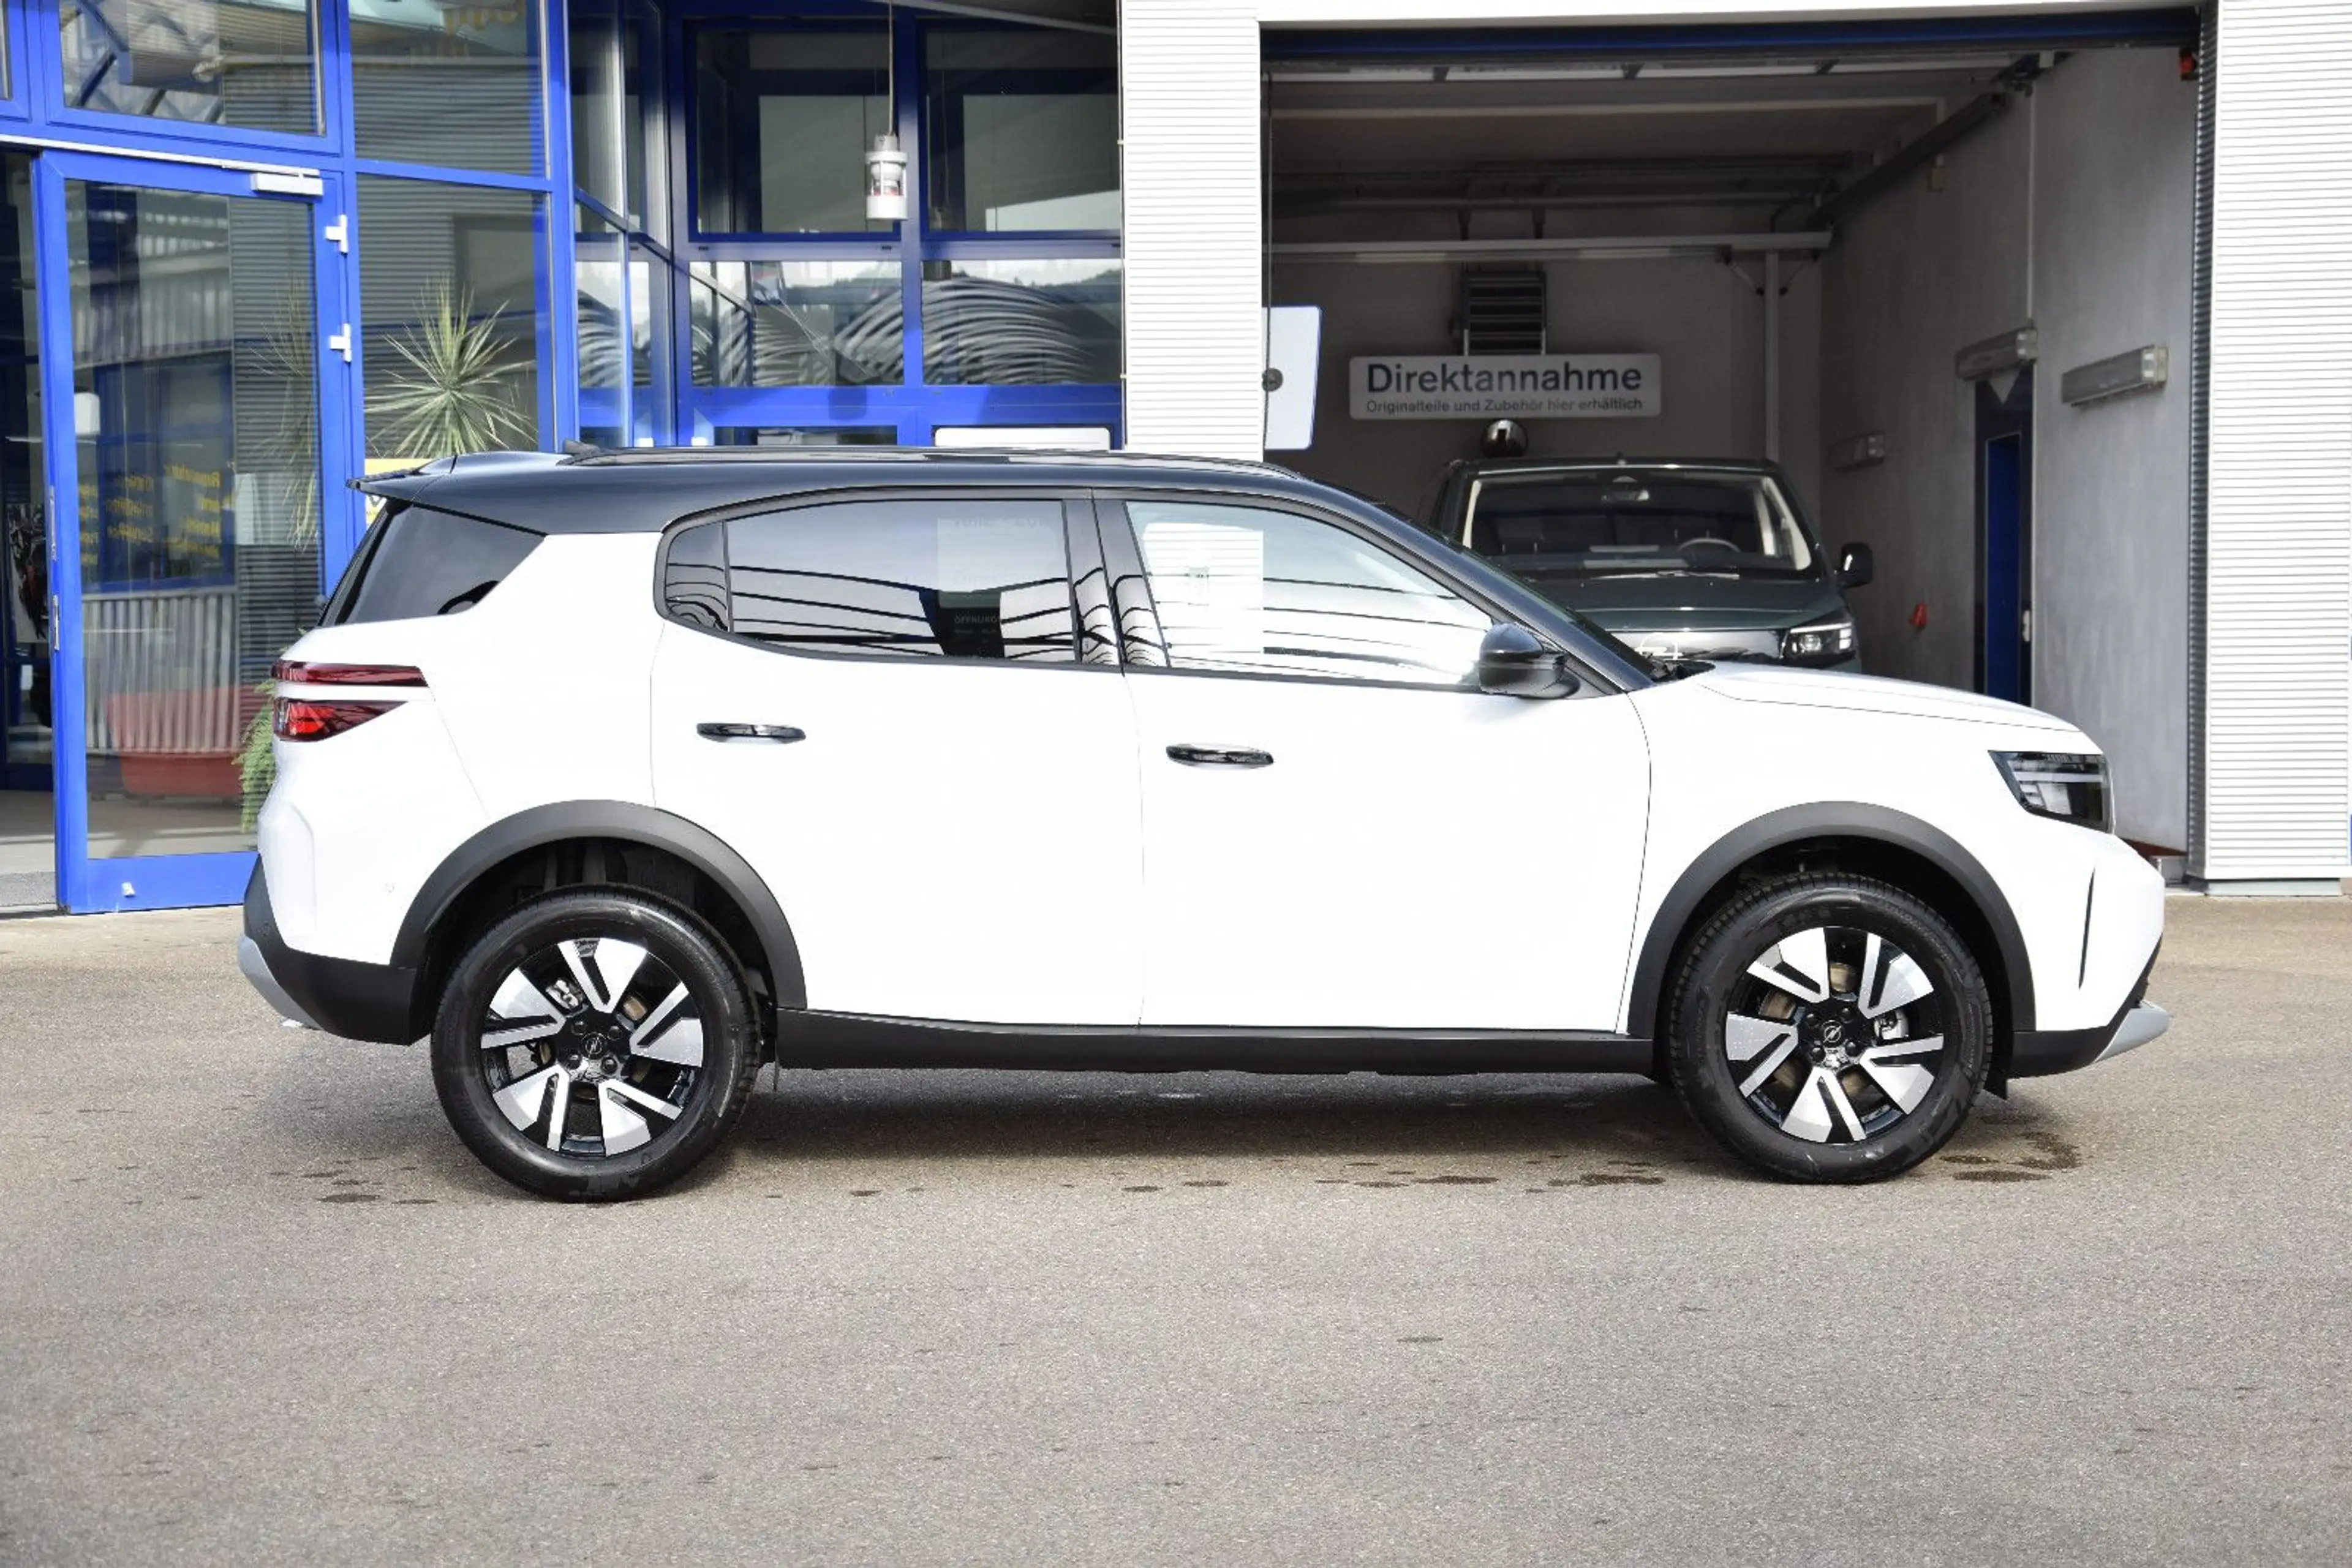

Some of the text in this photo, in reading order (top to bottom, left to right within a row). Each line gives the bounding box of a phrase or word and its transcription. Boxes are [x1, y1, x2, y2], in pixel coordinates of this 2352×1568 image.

[1367, 361, 1642, 393] Direktannahme
[1366, 396, 1643, 416] Originalteile und Zubehör hier erhältlich
